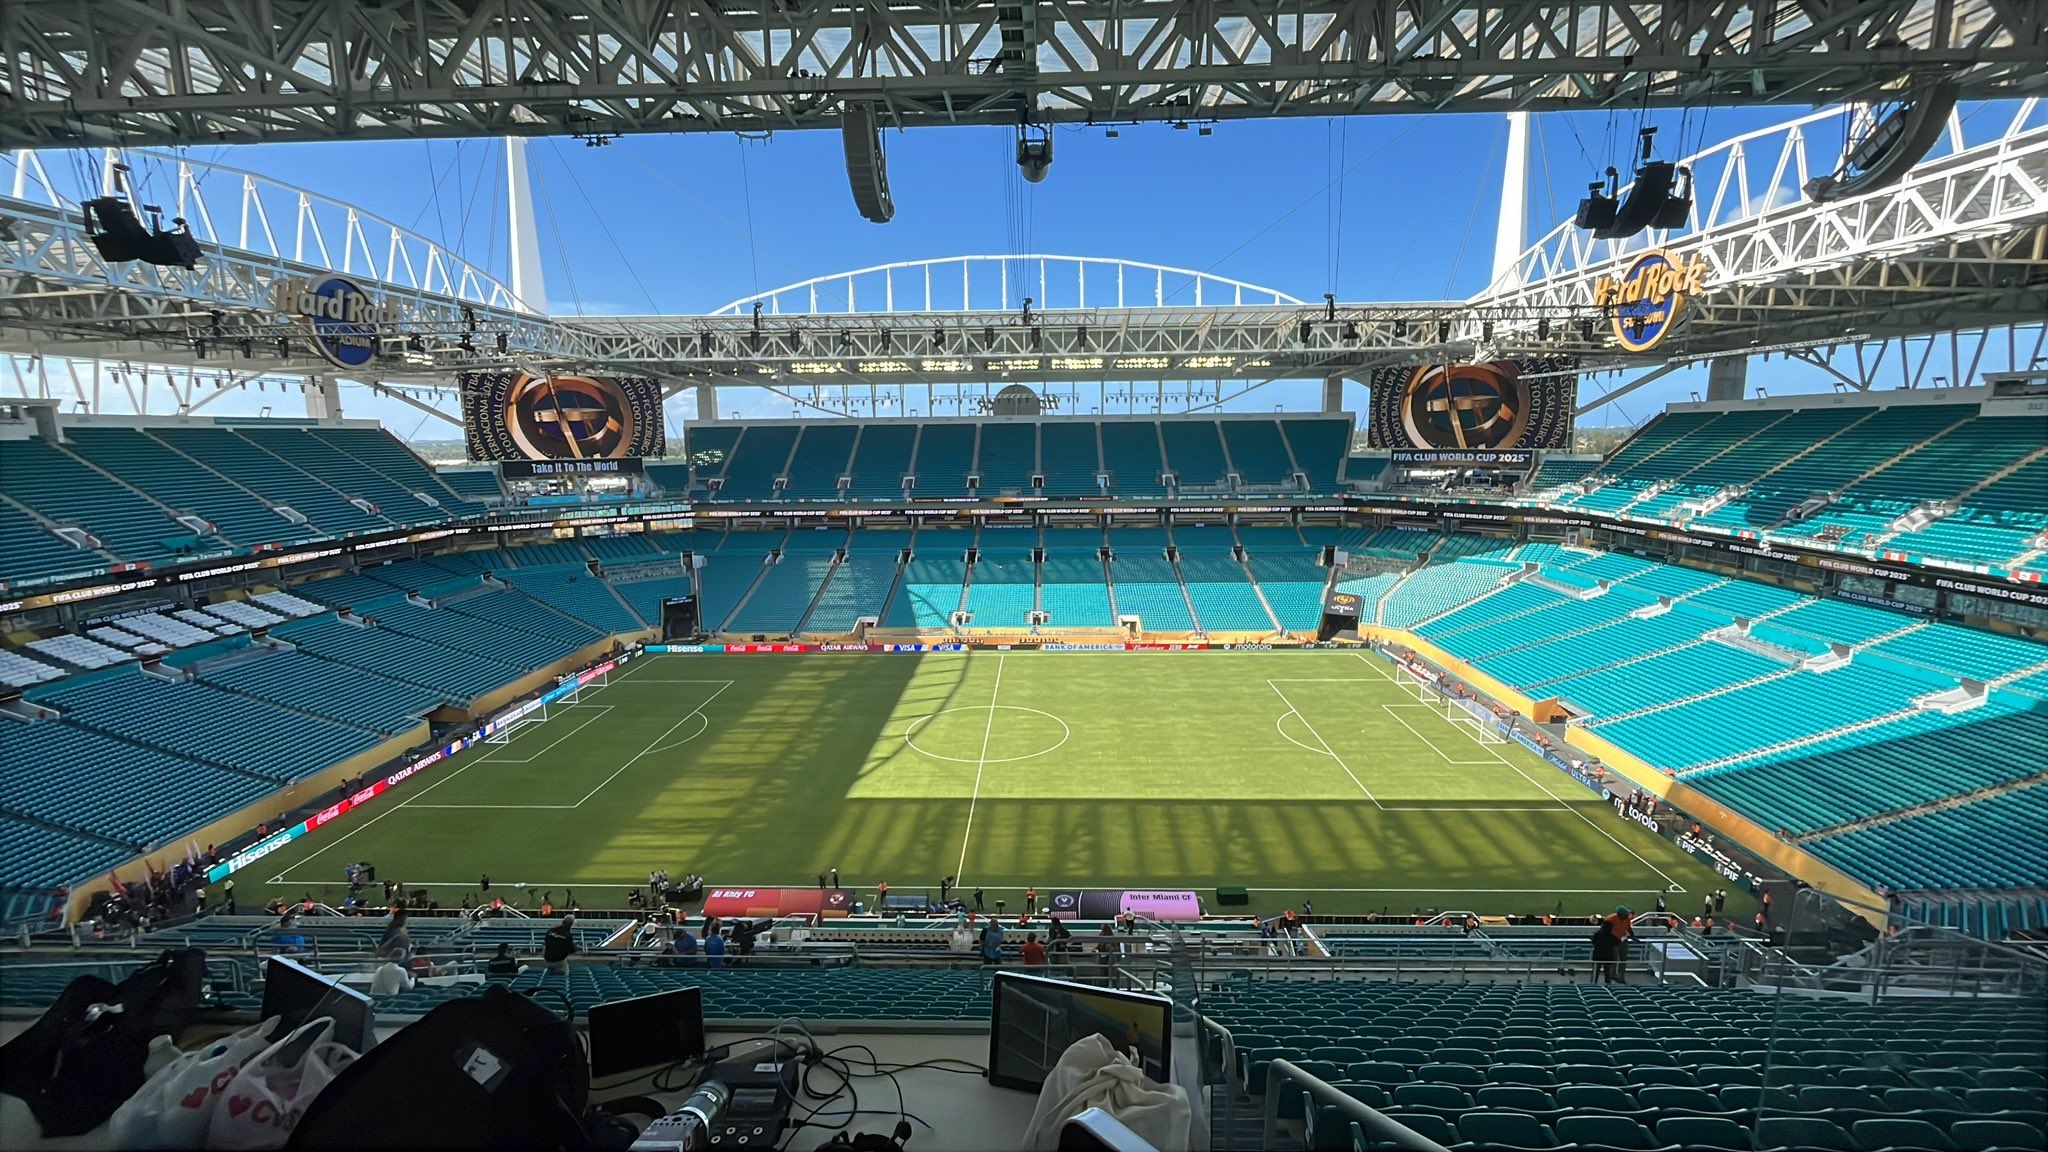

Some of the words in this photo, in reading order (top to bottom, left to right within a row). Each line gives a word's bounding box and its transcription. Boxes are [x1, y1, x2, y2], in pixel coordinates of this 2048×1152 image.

[1644, 252, 1706, 304] Rock
[276, 279, 344, 320] Hard
[346, 292, 400, 324] Rock
[494, 376, 510, 401] CLUB
[1395, 370, 1410, 394] CLUB
[618, 377, 637, 400] NTUS
[631, 401, 642, 446] FOOTBALL
[1380, 387, 1395, 448] TERNACIONAL
[1391, 394, 1405, 442] FOOTBALL
[1522, 385, 1542, 436] FOOTBALL
[1534, 395, 1556, 443] SALZBURG
[494, 404, 515, 453] FOOTBALL
[652, 418, 664, 456] FLAMENG
[1547, 404, 1569, 449] FLAMENG
[531, 463, 553, 474] Take
[555, 462, 563, 473] It
[563, 462, 574, 473] To
[576, 462, 592, 472] The
[594, 461, 619, 472] World
[1393, 453, 1412, 461] FIFA
[1414, 453, 1438, 461] CLUB
[1439, 453, 1474, 461] WORLD
[1476, 453, 1496, 461] CUP
[1753, 548, 1772, 557] WORLD
[179, 573, 195, 581] FIFA
[194, 570, 211, 578] CLUB
[210, 566, 232, 576] WORLD
[1833, 561, 1849, 570] CLUB
[1850, 564, 1874, 574] WORLD
[1874, 568, 1889, 576] CUP
[53, 593, 72, 603] FIFA
[72, 590, 93, 600] CLUB
[94, 585, 121, 596] WORLD
[121, 582, 136, 591] CUP
[1837, 590, 1851, 598] FIFA
[1851, 592, 1867, 601] CLUB
[1867, 596, 1891, 606] WORLD
[1891, 601, 1905, 609] CUP
[1936, 579, 1954, 589] FIFA
[1954, 581, 1976, 593] CLUB
[1977, 585, 2009, 598] WORLD
[2010, 591, 2029, 601] CUP
[2030, 595, 2048, 605] 202
[667, 645, 704, 653] Hisense
[1517, 734, 1538, 751] AMERICA
[388, 767, 413, 785] QATAR
[413, 751, 441, 772] AIRWAYS
[1571, 768, 1591, 788] ULTRA
[1614, 797, 1658, 833] mtorola
[229, 833, 292, 874] Hisense
[1682, 840, 1696, 854] PIF
[1723, 867, 1739, 882] PIF
